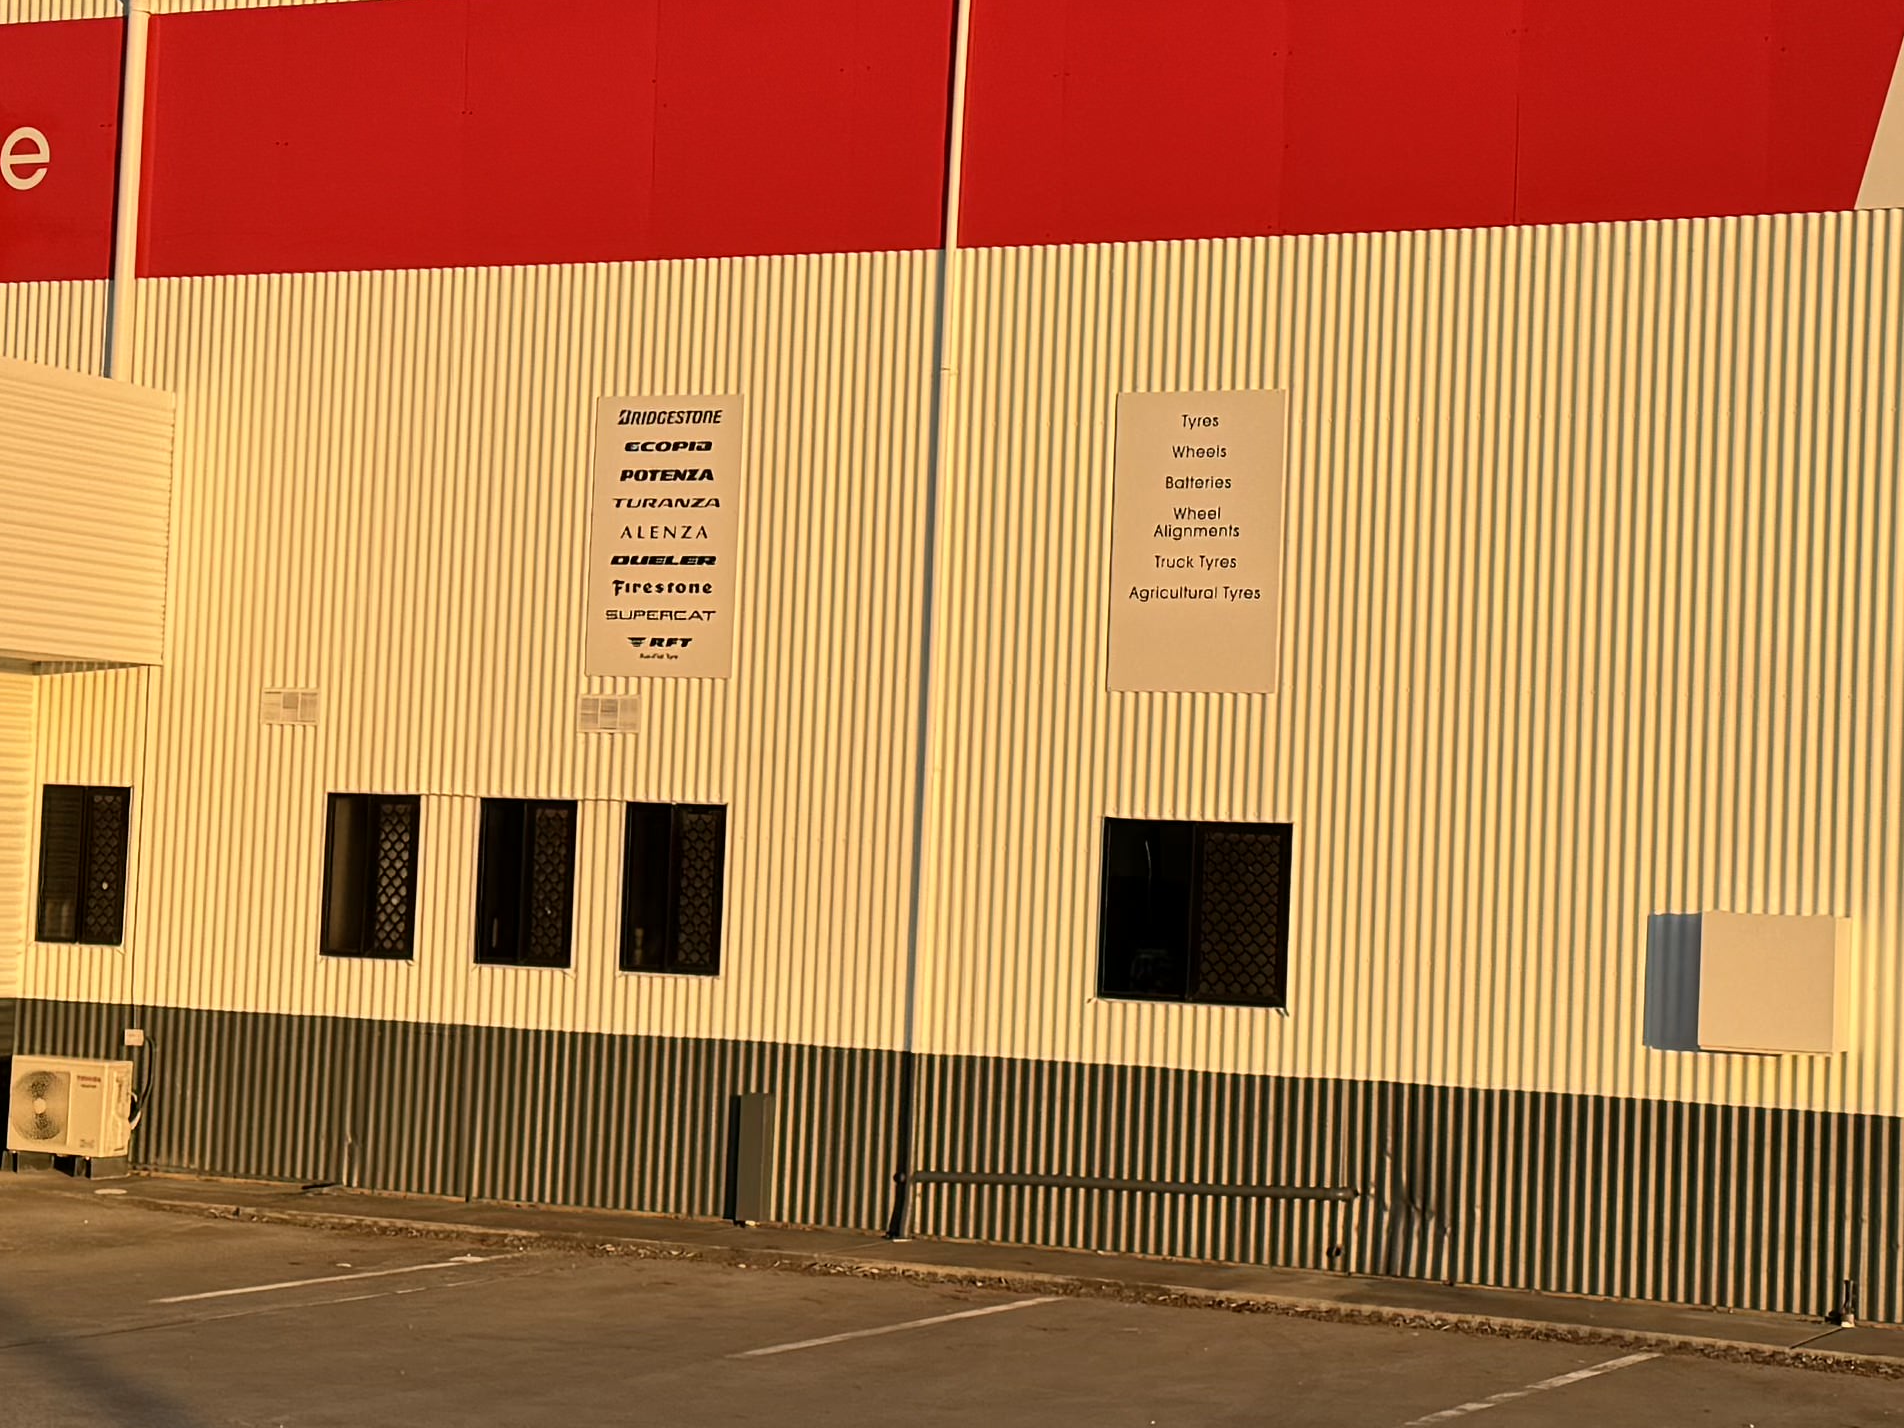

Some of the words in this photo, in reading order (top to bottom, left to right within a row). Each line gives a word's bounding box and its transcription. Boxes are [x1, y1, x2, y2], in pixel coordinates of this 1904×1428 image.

[618, 410, 722, 425] BRIDGESTONE
[1182, 415, 1218, 430] Tyres
[625, 441, 712, 452] ECOPIA
[1173, 445, 1226, 458] Wheels
[620, 469, 713, 481] POTENZA
[1166, 476, 1231, 489] Batteries
[614, 498, 720, 508] TURANZA
[1174, 507, 1220, 520] Wheel
[621, 526, 707, 539] ALENZA
[1154, 525, 1239, 540] Alignments
[611, 556, 716, 565] DUELER
[1155, 555, 1193, 568] Truck
[1200, 555, 1236, 570] Tyres
[612, 580, 712, 596] Firestone
[1129, 586, 1217, 602] Agricultural
[1223, 586, 1260, 601] Tyres
[606, 610, 716, 620] SUPERCAT
[650, 638, 692, 647] RFT
